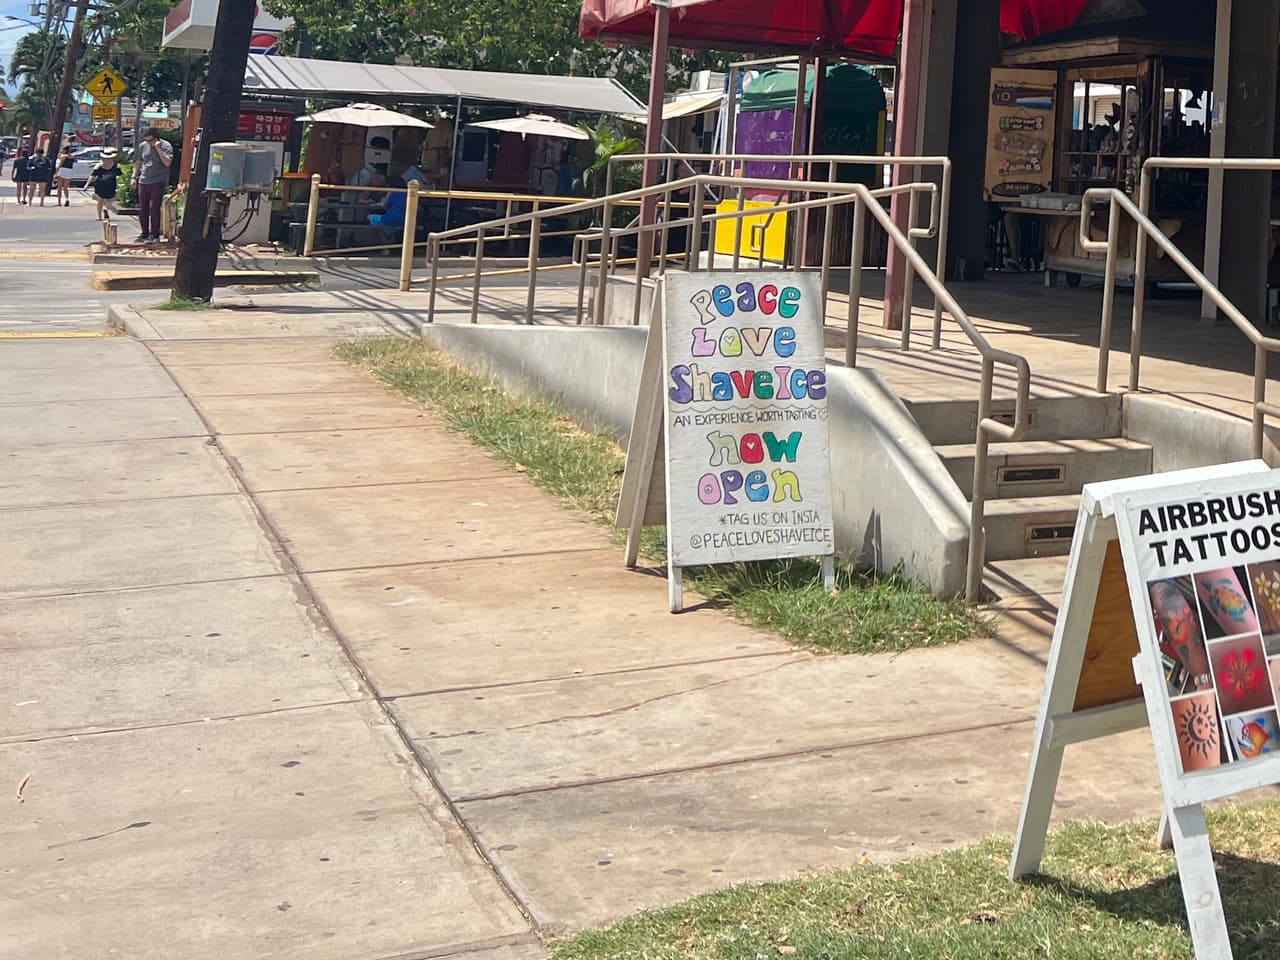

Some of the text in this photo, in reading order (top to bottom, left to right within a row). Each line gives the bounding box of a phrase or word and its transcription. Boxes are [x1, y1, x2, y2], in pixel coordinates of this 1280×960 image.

[673, 414, 691, 427] AN
[694, 411, 754, 426] EXPERIENCE
[755, 410, 784, 423] WORTH
[753, 512, 768, 526] US
[772, 511, 789, 525] ON
[792, 509, 821, 522] INSTA
[689, 527, 832, 549] @PEACELOVESHAVEICE
